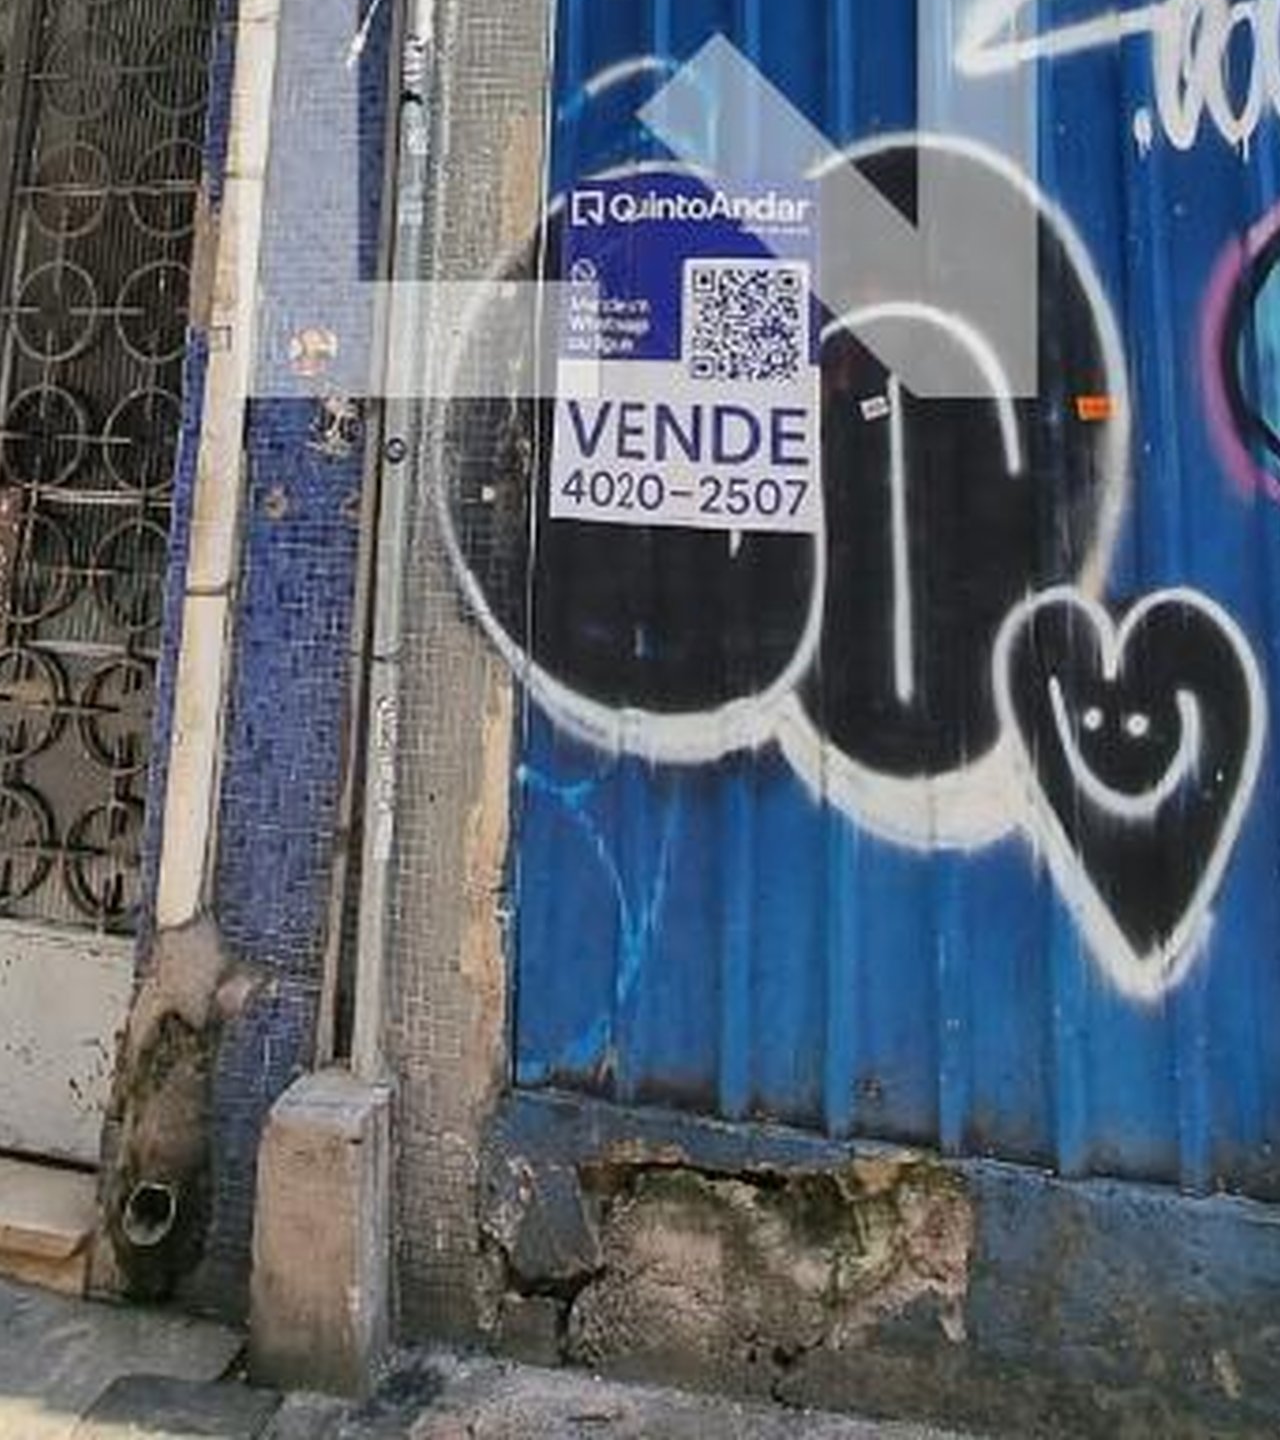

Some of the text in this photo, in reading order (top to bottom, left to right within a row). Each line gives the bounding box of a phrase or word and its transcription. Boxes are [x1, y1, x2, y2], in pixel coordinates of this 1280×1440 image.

[609, 190, 811, 223] QuintoAndar
[567, 400, 810, 466] VENDE
[561, 468, 809, 516] 4020-2507
